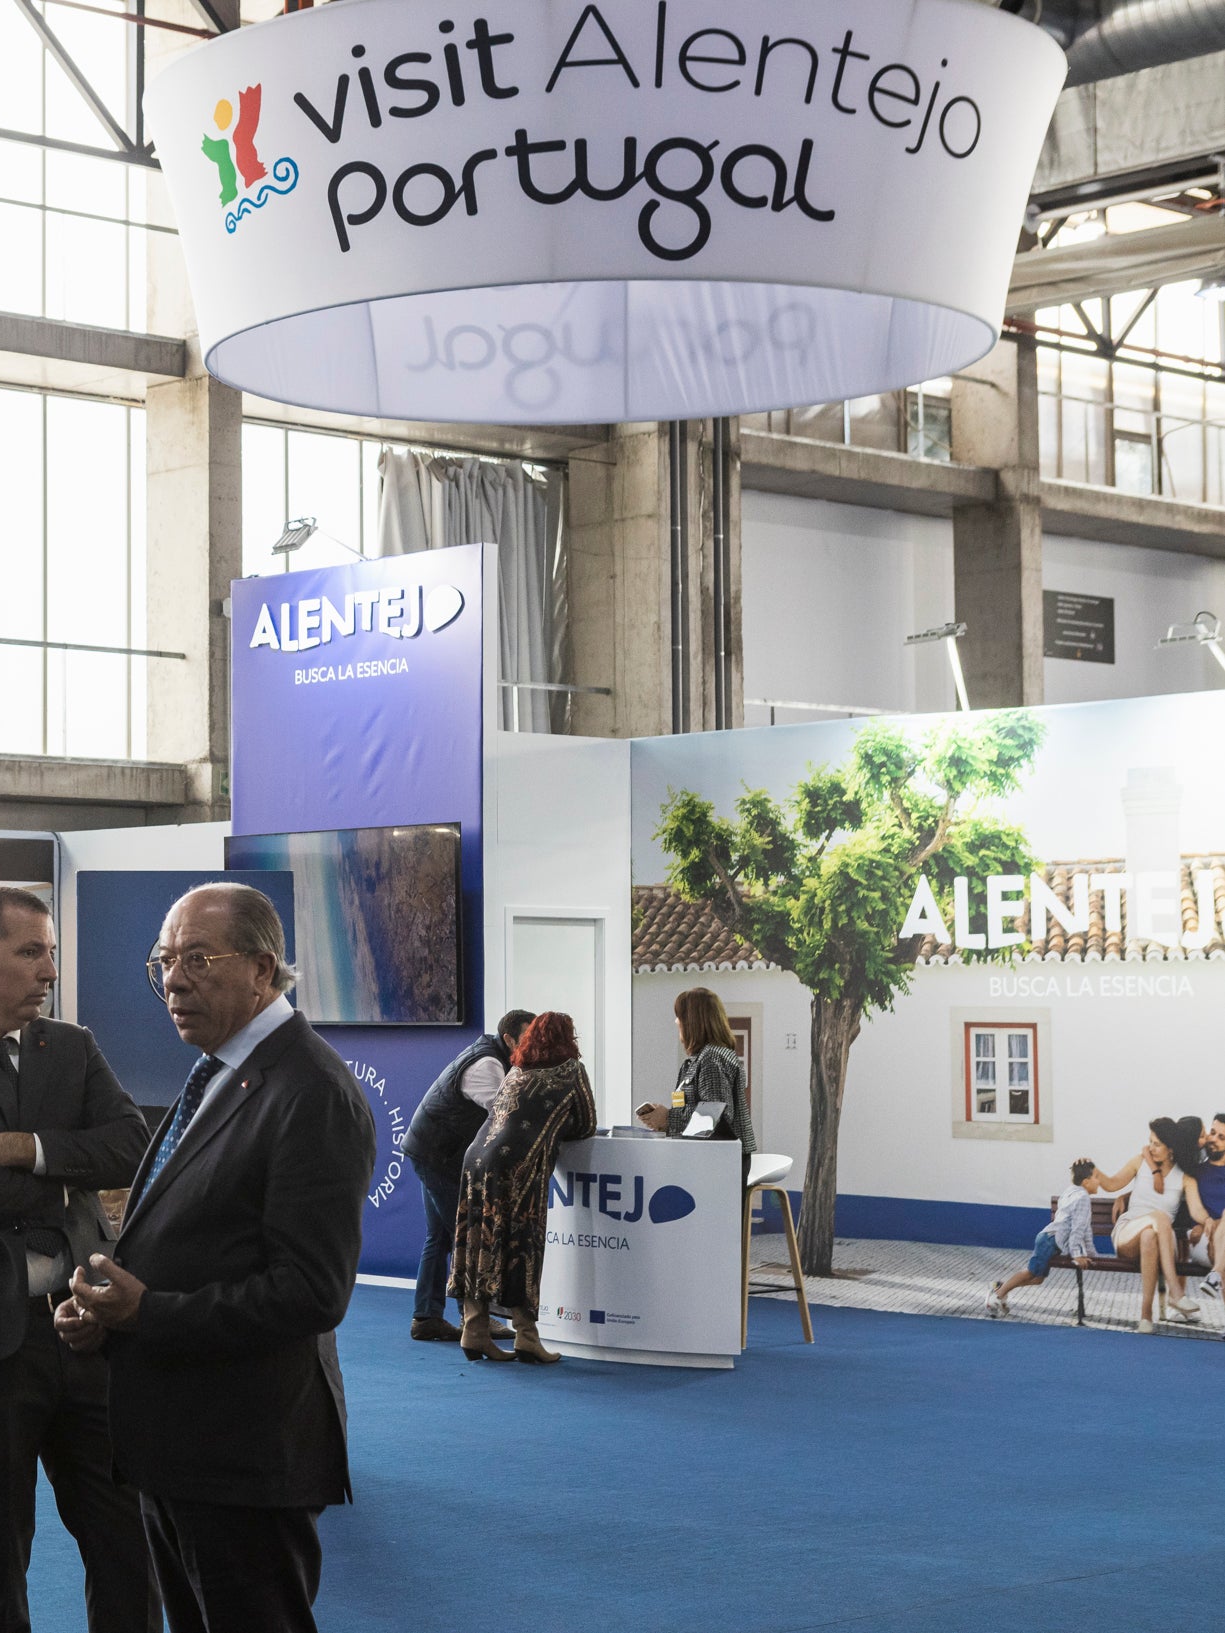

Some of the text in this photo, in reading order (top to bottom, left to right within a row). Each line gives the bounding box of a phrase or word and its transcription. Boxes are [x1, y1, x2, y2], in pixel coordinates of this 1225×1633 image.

[294, 0, 982, 160] visit Alentejo
[327, 129, 836, 262] portugal
[294, 658, 409, 685] BUSCA LA ESENCIA
[898, 869, 1225, 950] ALENTEJ
[989, 975, 1195, 998] BUSCA LA ESENCIA
[562, 1233, 576, 1246] LA
[578, 1234, 630, 1251] ESENCIA
[563, 1310, 582, 1322] 2030
